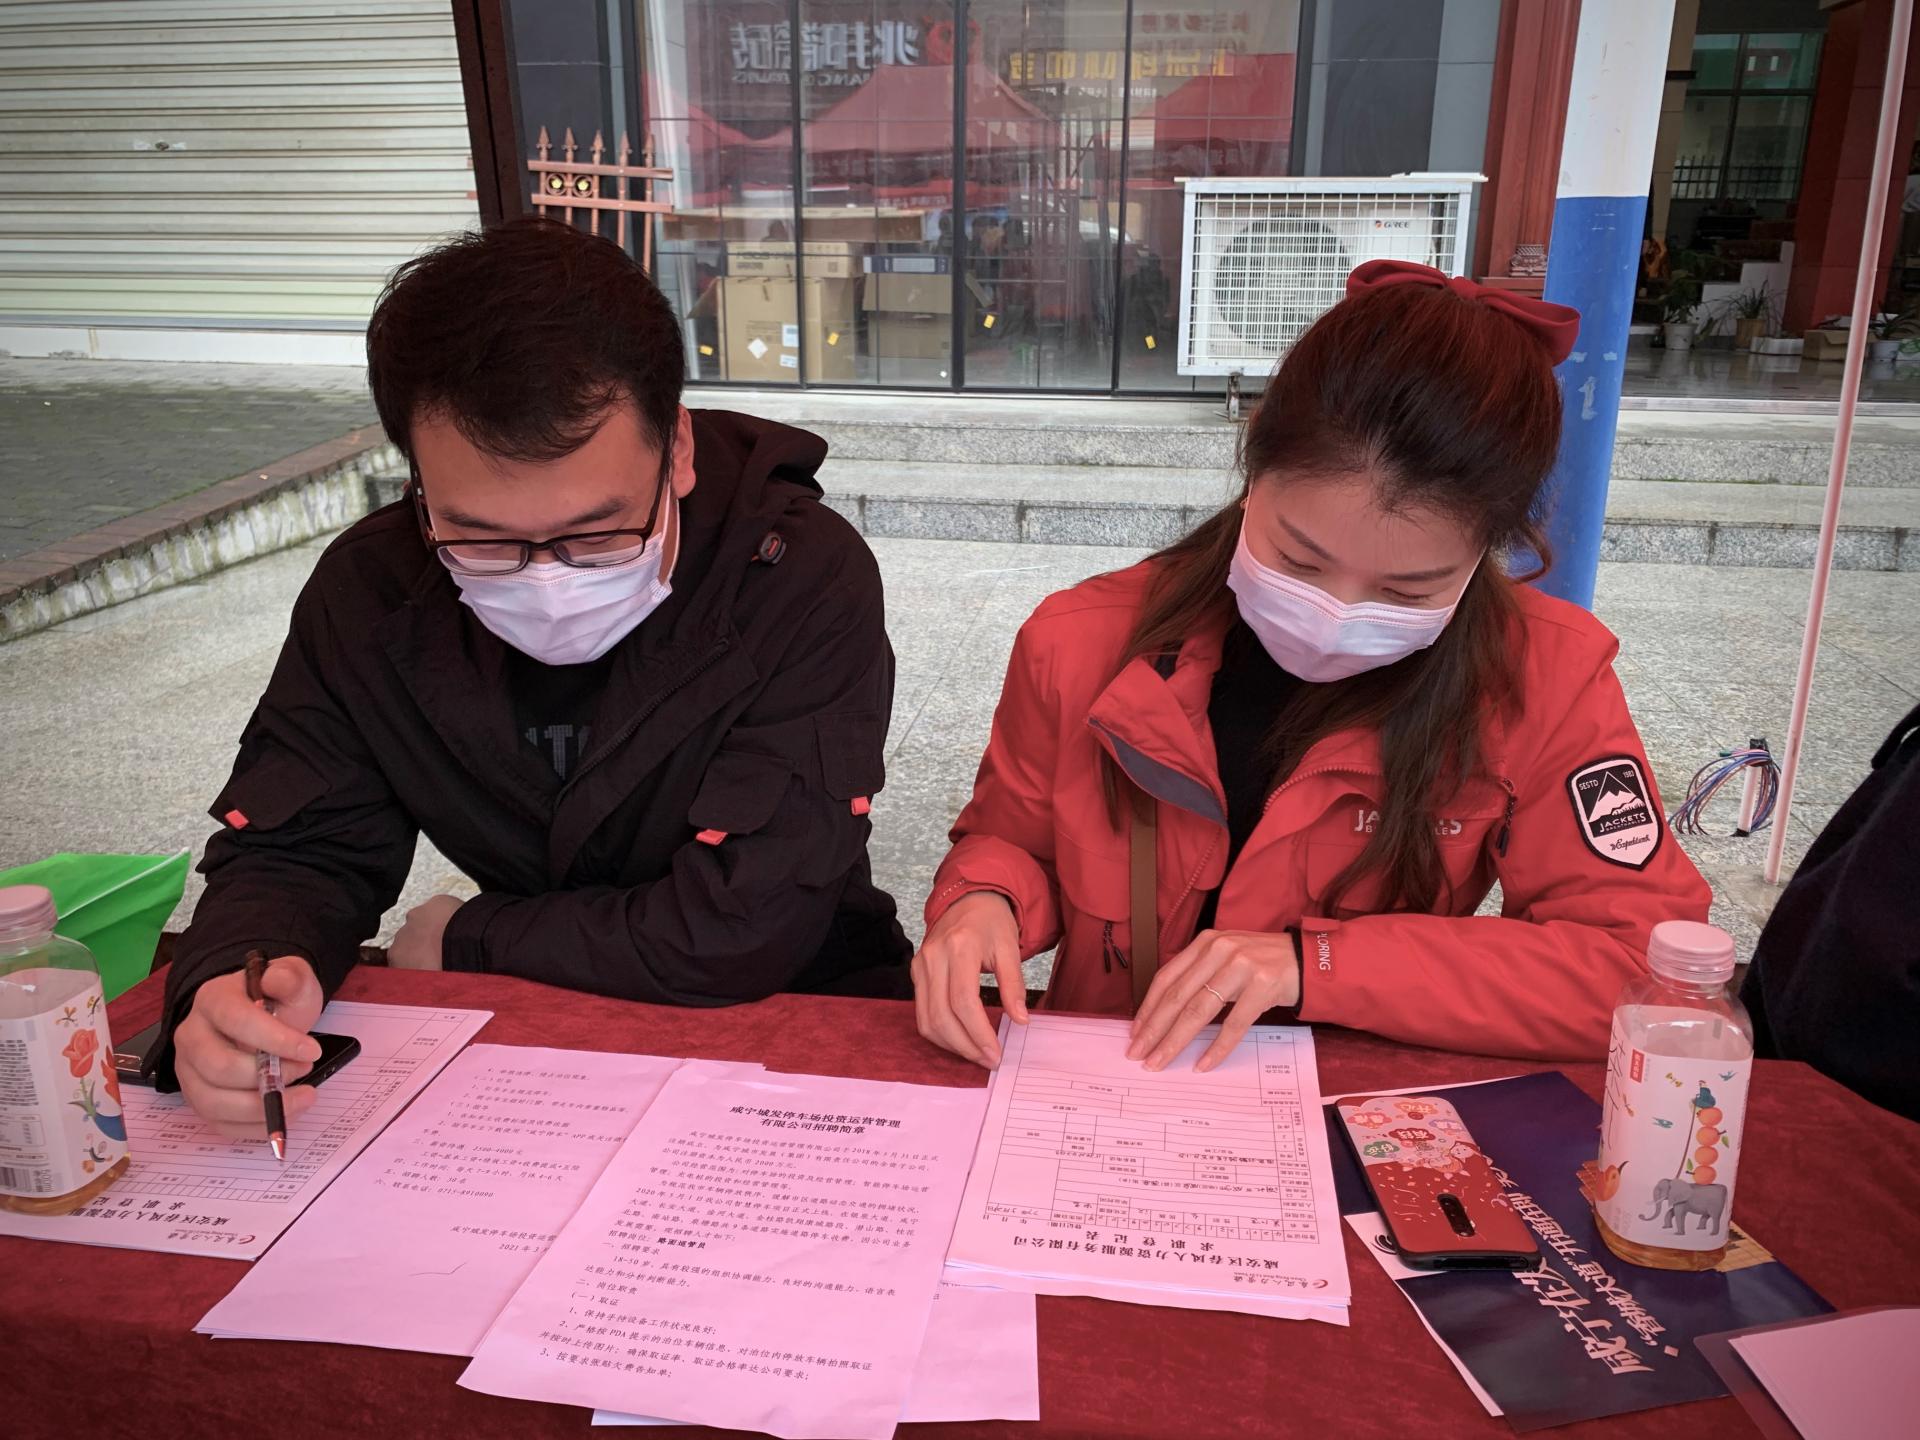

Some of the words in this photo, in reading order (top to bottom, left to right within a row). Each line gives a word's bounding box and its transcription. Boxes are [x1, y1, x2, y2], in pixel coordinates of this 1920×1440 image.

[1599, 811, 1646, 834] JACKETS
[729, 1105, 901, 1129] 咸宁城发停车场投资运营管理
[760, 1117, 866, 1135] 有限公司招聘简章
[1013, 1235, 1279, 1270] 咸安区春风人力资源服务有限公司
